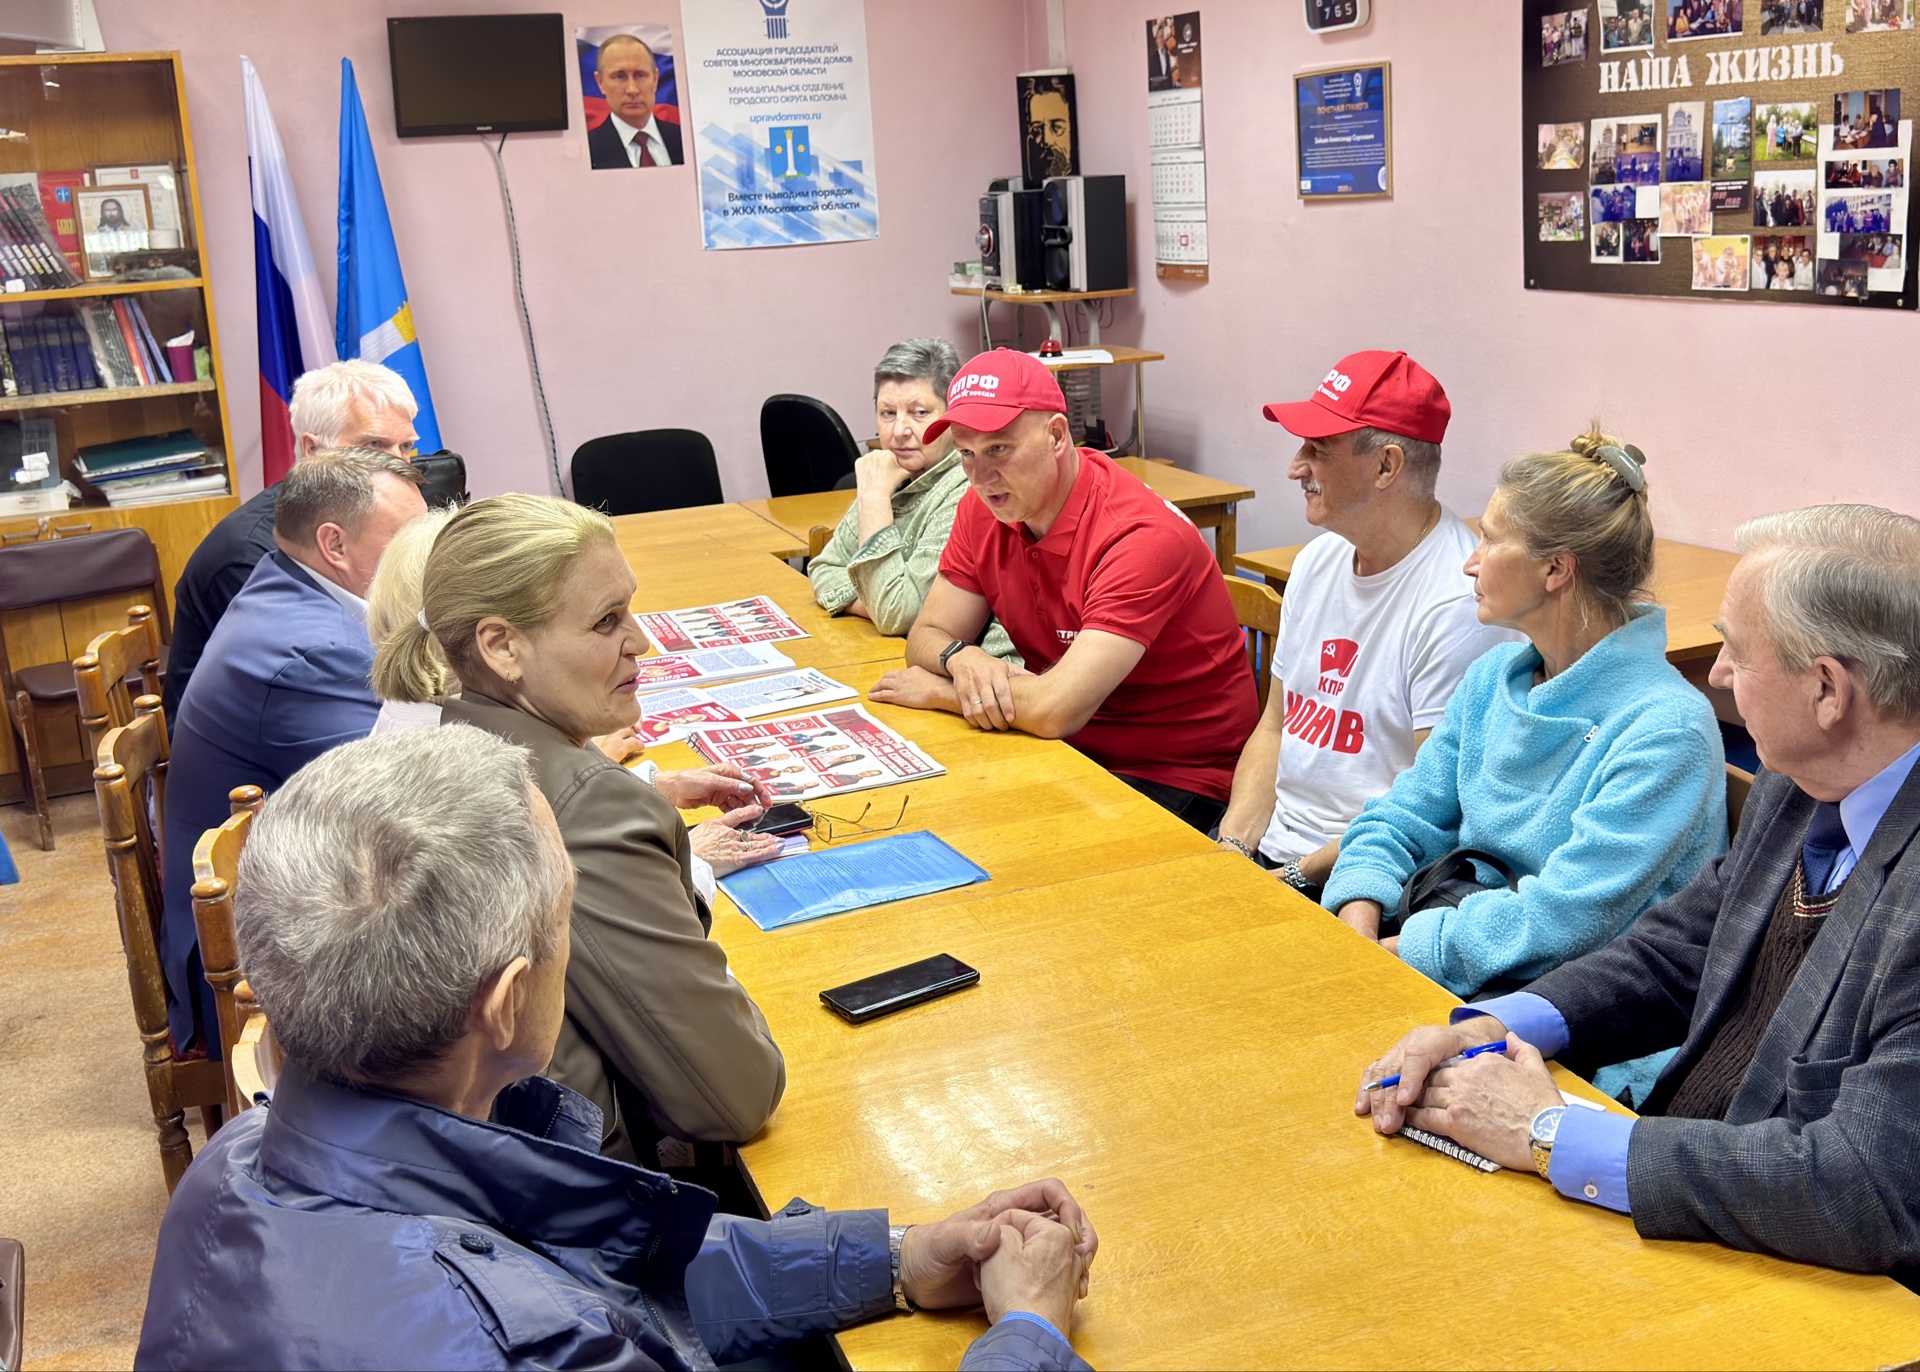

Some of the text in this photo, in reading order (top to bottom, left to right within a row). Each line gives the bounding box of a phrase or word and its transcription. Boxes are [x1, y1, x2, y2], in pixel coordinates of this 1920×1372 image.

[716, 44, 839, 57] АССОЦИАЦИЯ ПРЕДСЕДАТЕЛЕЙ
[703, 55, 853, 68] СОВЕТОВ МНОГОКВАРТИРНЫХ ДОМОВ
[1599, 41, 1844, 94] НАША ЖИЗНЬ
[733, 67, 827, 78] МОСКОВСКОЙ ОБЛАСТИ
[728, 82, 844, 95] МУНИЦИПАЛЬНОЕ ОТДЕЛЕНИЕ
[729, 93, 847, 106] ГОРОДСКОГО ОКРУГА КОЛОМНА
[749, 111, 822, 125] upravdommo.ru
[728, 188, 853, 202] Вместе наводим порядок
[723, 200, 860, 217] в ЖКХ Московской области
[950, 374, 1000, 398] КПРФ
